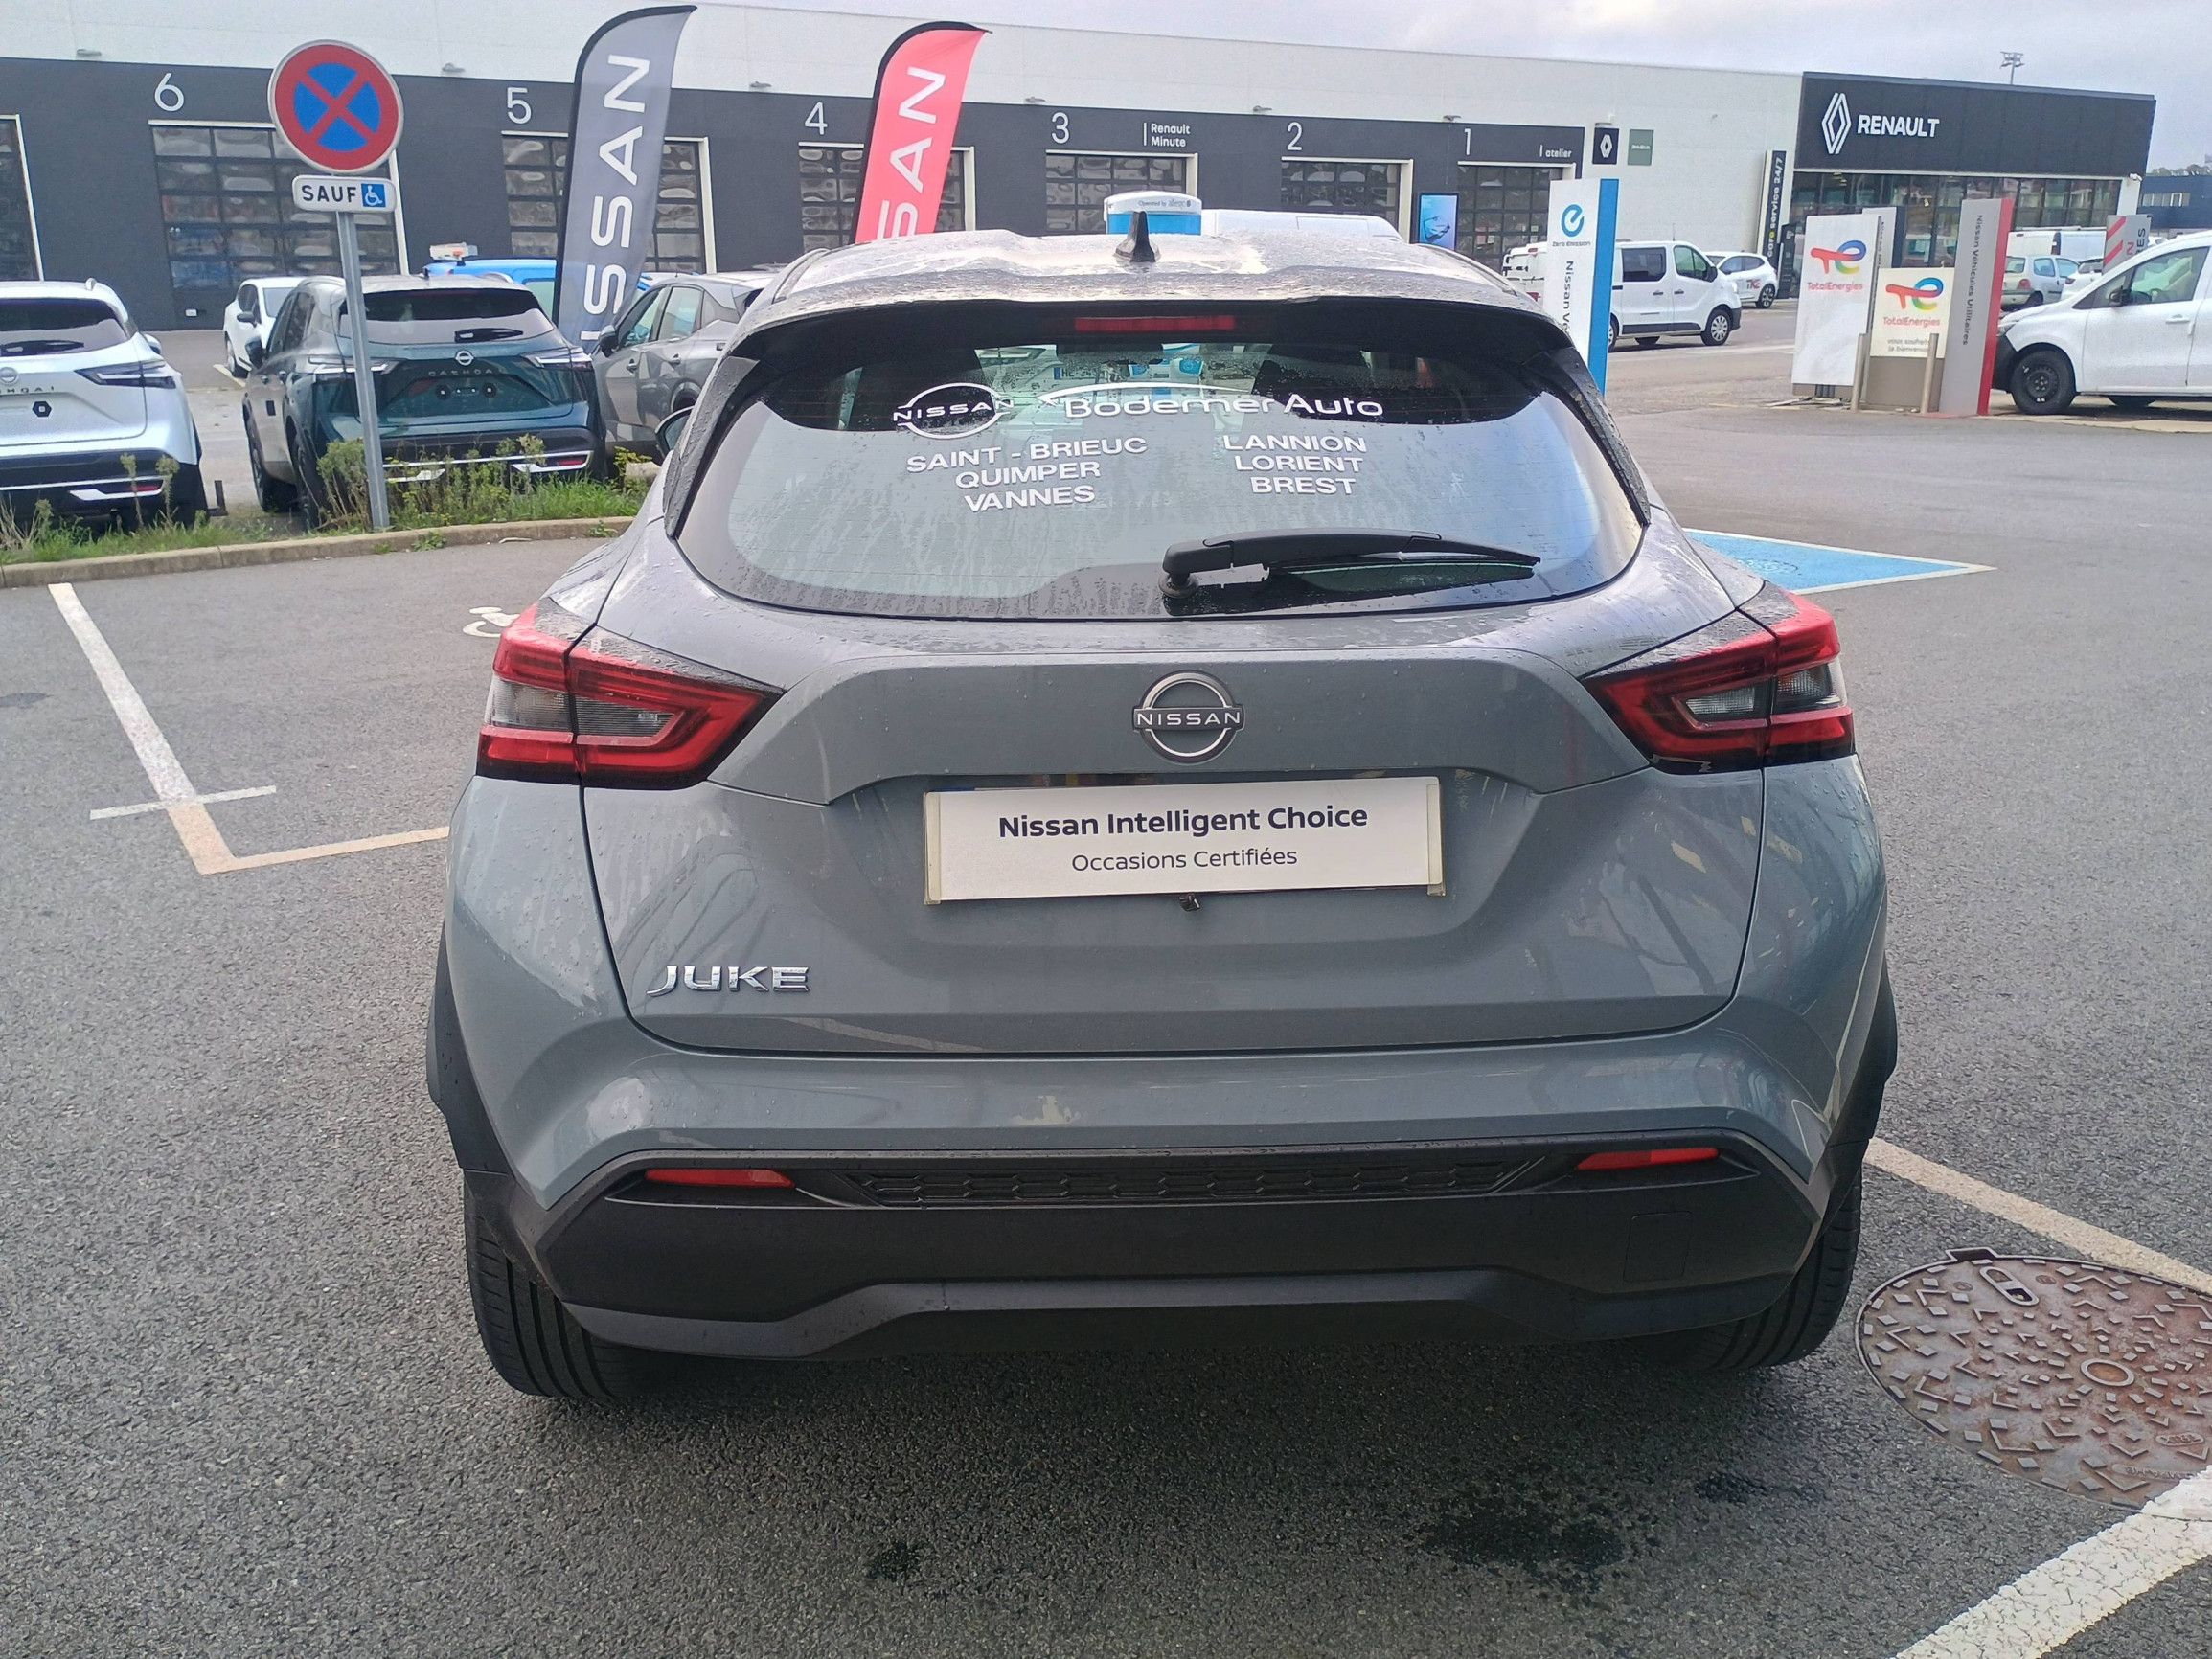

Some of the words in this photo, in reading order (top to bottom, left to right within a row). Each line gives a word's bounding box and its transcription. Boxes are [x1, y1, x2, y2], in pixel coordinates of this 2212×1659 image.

[154, 72, 185, 112] 6
[506, 87, 532, 124] 5
[804, 102, 828, 135] 4
[1051, 111, 1070, 144] 3
[1151, 123, 1191, 135] Renault
[1857, 114, 1940, 138] RENAULT
[1151, 136, 1187, 148] Minute
[1287, 122, 1303, 151] 2
[1464, 128, 1471, 155] 1
[1545, 148, 1572, 158] atelier
[1773, 157, 1783, 184] 24/7
[301, 184, 357, 203] SAUF
[1769, 187, 1780, 229] service
[1973, 215, 1983, 249] Nissan
[1562, 261, 1574, 310] Nissan
[1807, 282, 1864, 292] TotalEnergies
[1882, 316, 1941, 328] TotalEnergies
[1962, 299, 1974, 346] Utilitaires
[892, 398, 1015, 422] NISSAN
[1064, 395, 1275, 419] Bodemer
[1284, 394, 1384, 417] Auto
[906, 446, 1002, 473] SAINT
[1030, 437, 1149, 461] BRIEUC
[1222, 435, 1367, 453] LANNION
[955, 460, 1101, 489] QUIMPER
[1234, 455, 1364, 473] LORIENT
[964, 485, 1096, 512] VANNES
[1250, 476, 1357, 494] BREST
[1137, 711, 1241, 726] NISSAN
[998, 812, 1099, 839] Nissan
[1106, 808, 1261, 840] Intelligent
[1267, 805, 1369, 830] Choice
[1071, 851, 1187, 873] Occasions
[1193, 848, 1298, 869] Certifiées
[646, 965, 810, 997] JUKE
